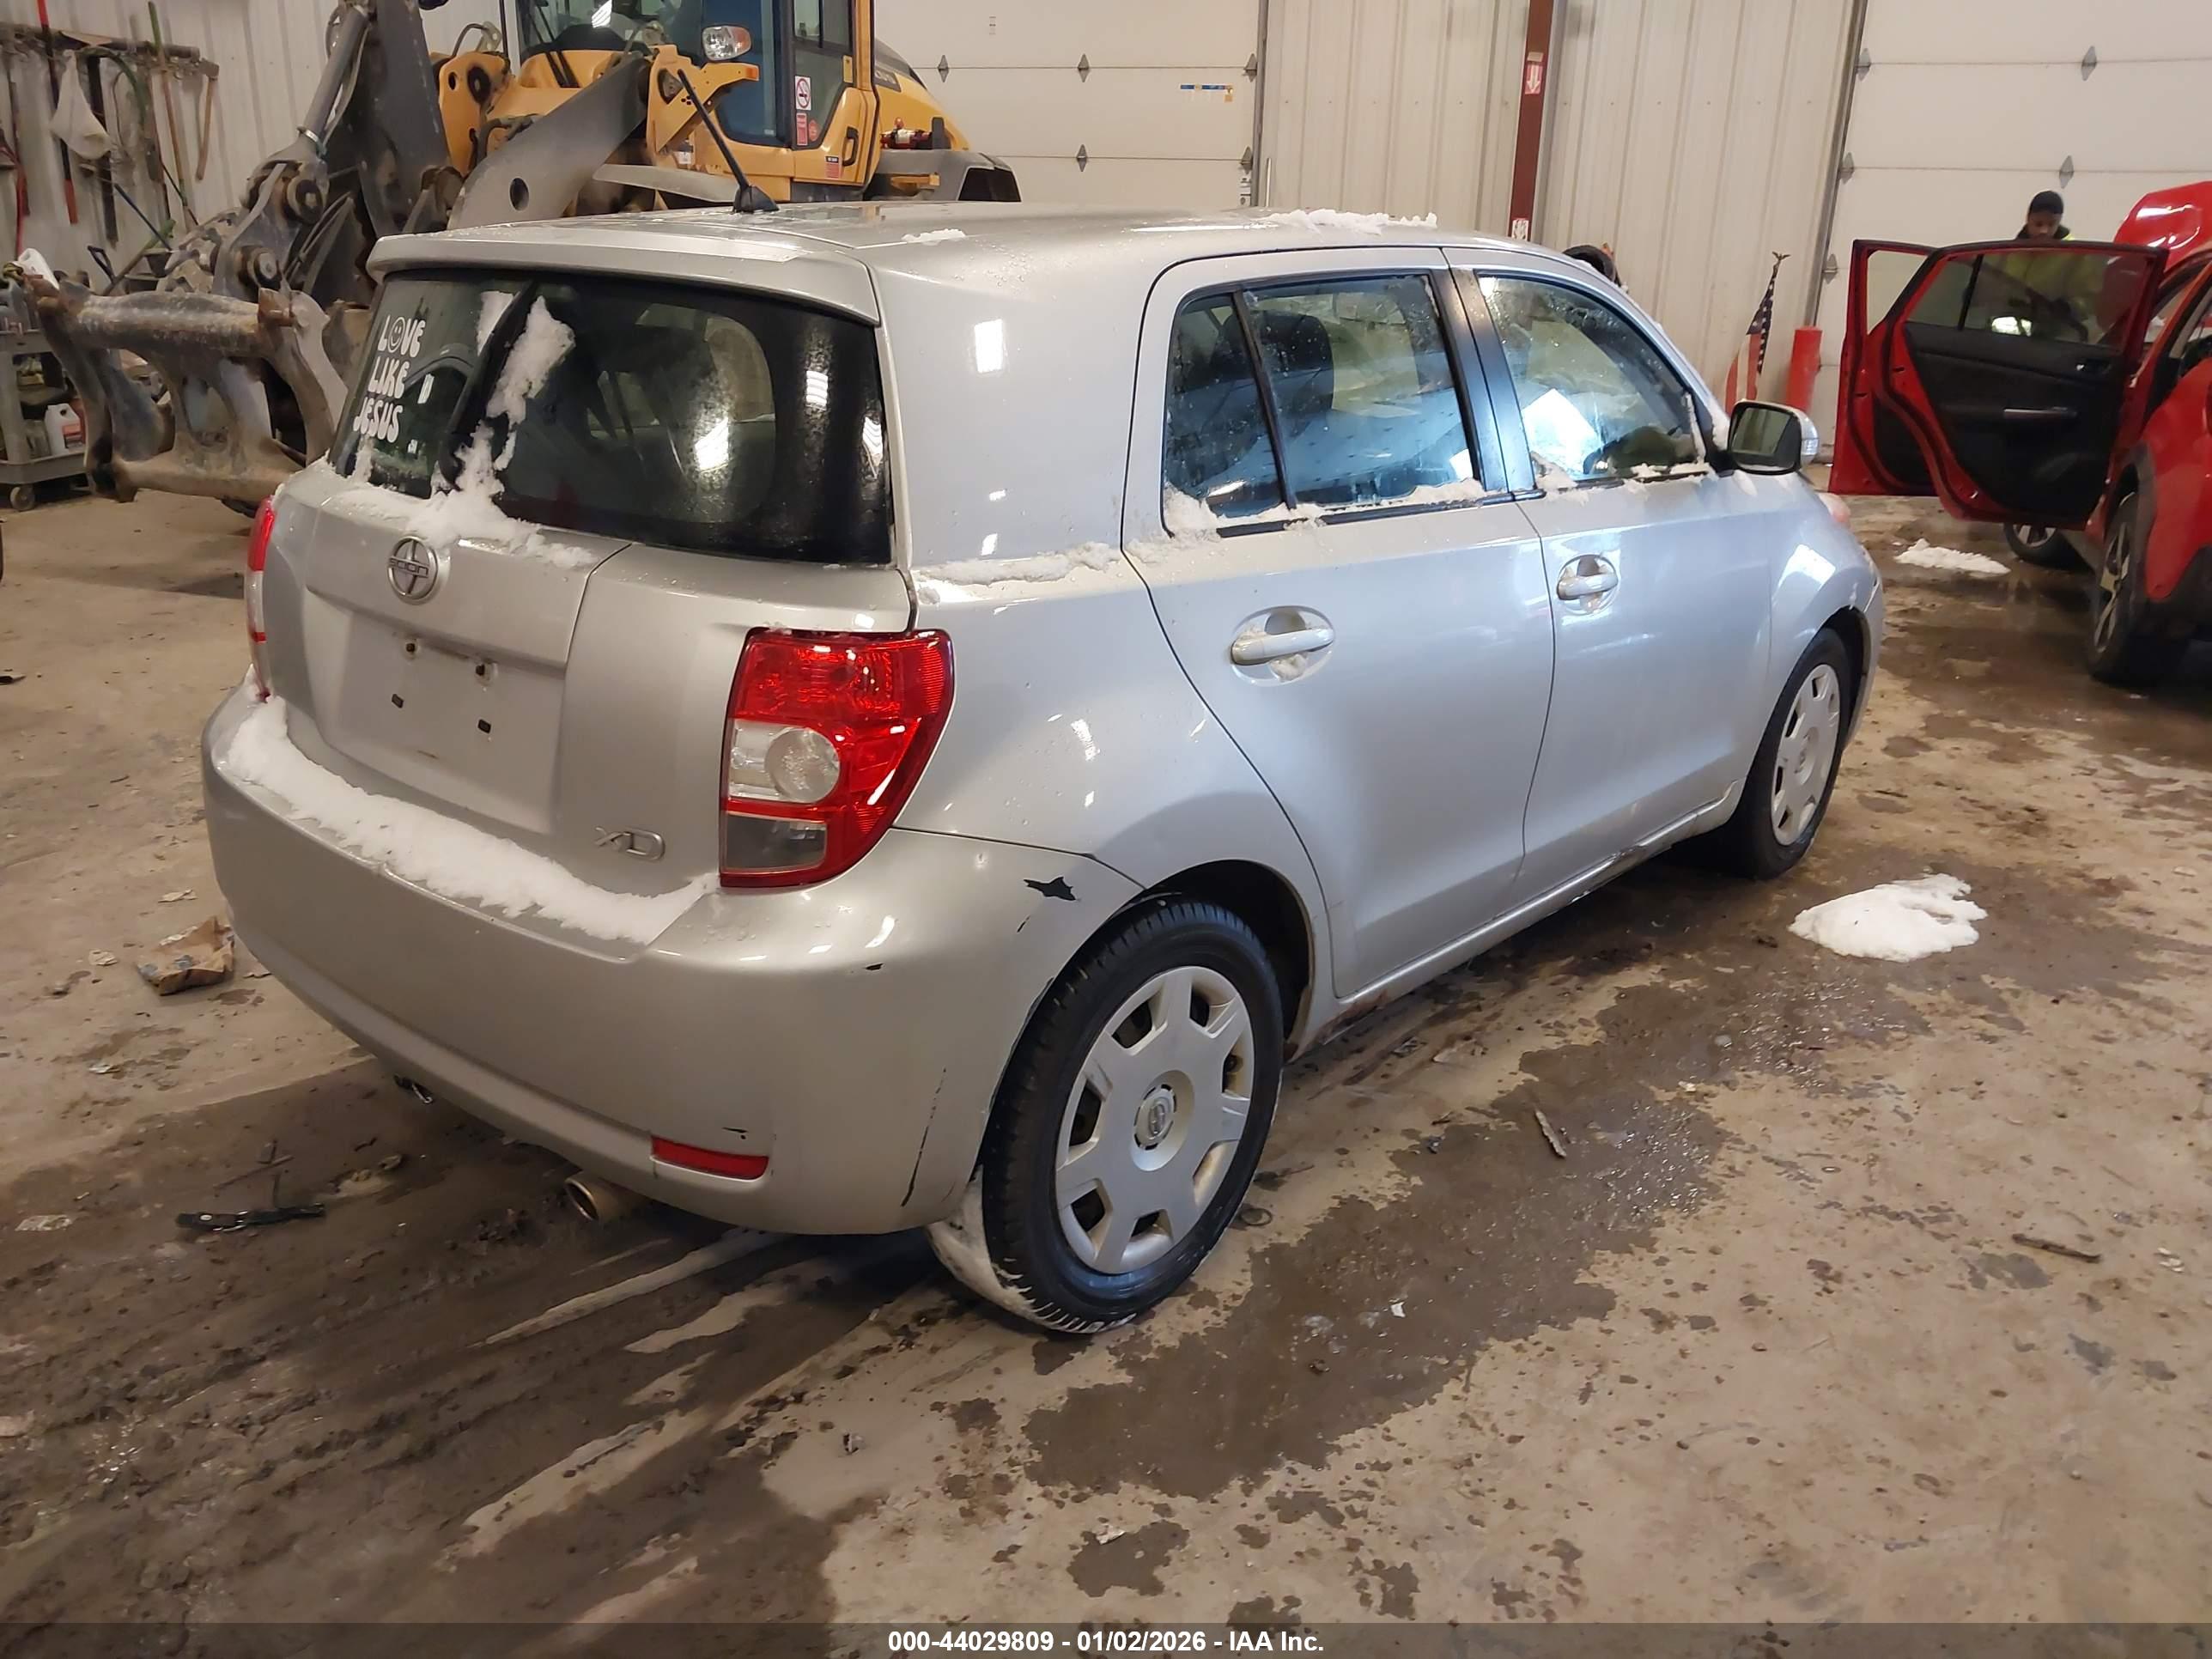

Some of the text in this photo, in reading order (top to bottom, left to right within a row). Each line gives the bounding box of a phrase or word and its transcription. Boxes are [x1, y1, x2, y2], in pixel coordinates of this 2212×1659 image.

[378, 314, 426, 357] LOVE
[368, 356, 410, 398] LIKE
[353, 397, 403, 443] JESUS
